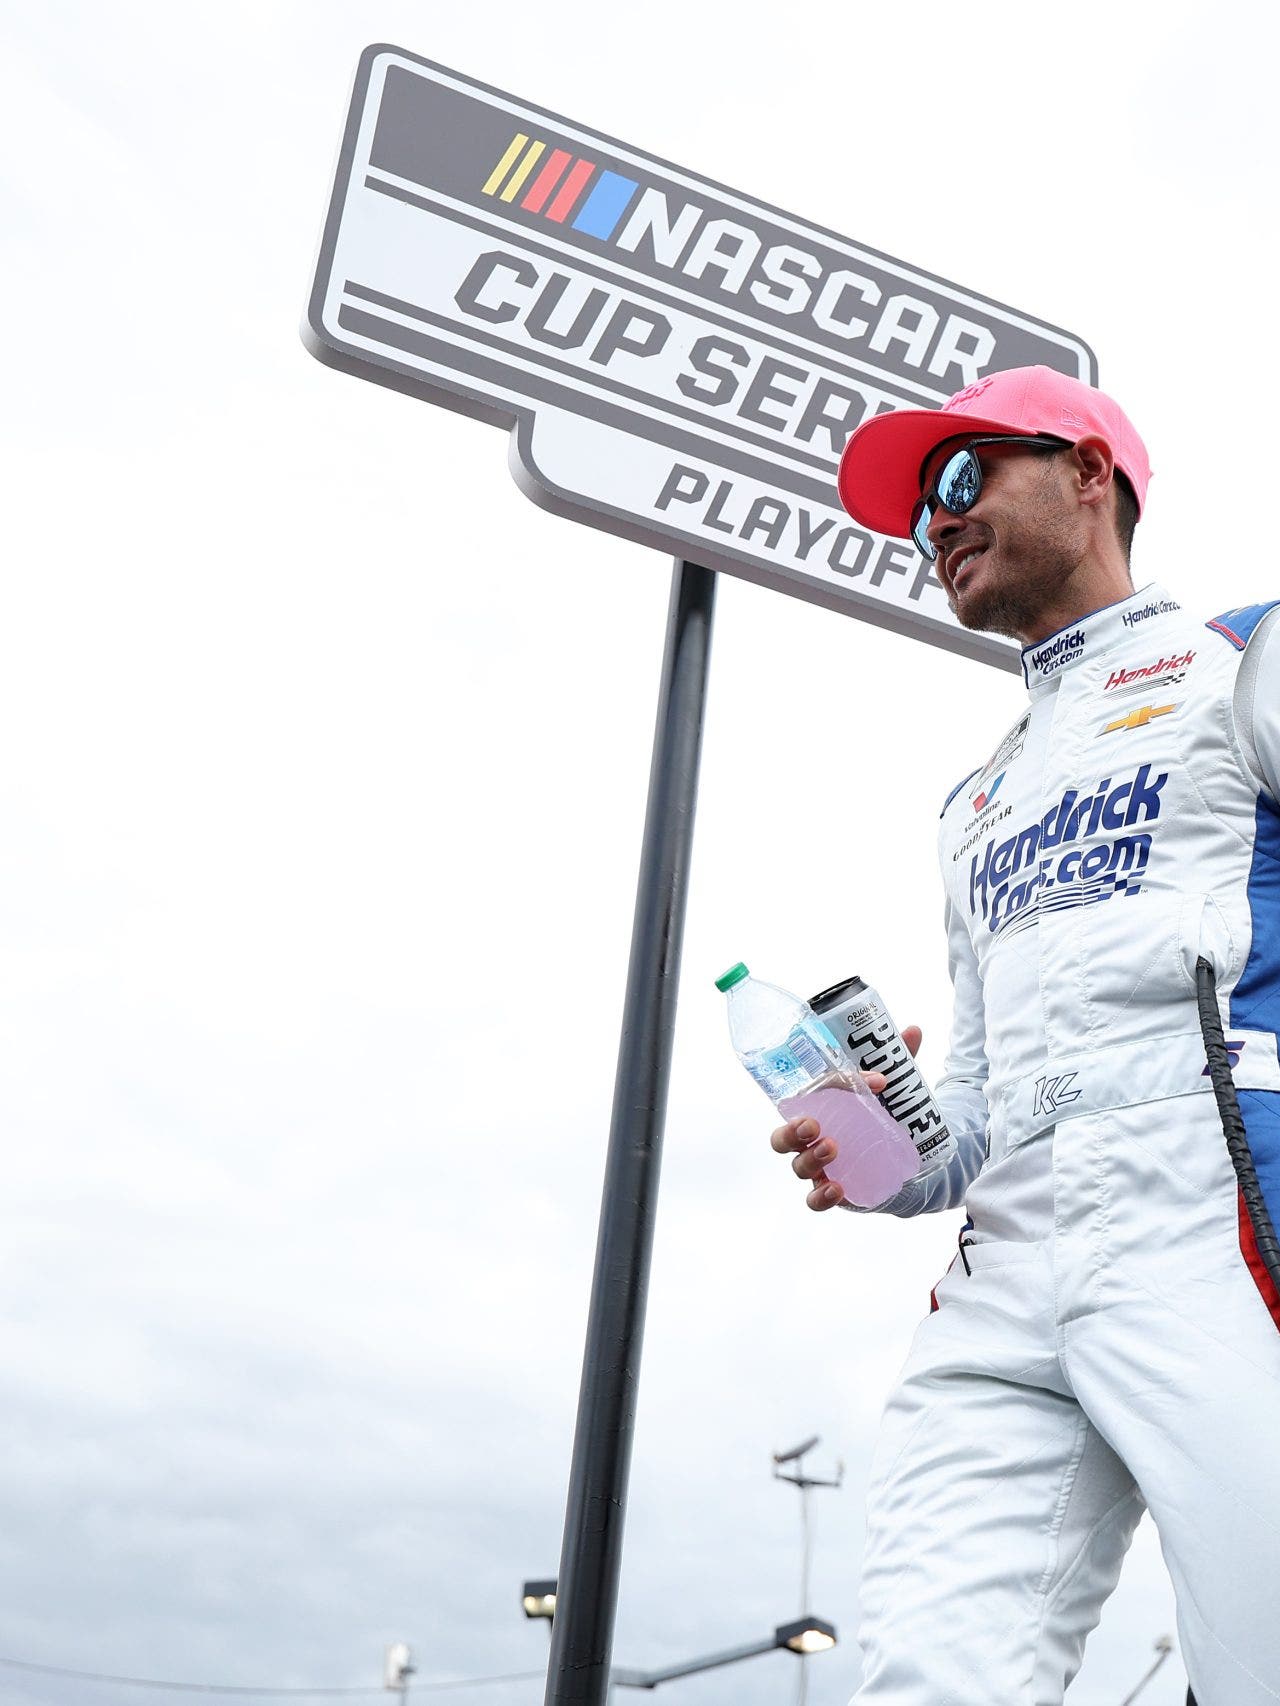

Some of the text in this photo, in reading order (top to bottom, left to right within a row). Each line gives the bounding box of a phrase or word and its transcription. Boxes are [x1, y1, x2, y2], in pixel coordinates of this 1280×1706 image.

[454, 250, 897, 454] CUP SER
[617, 187, 996, 384] NASCAR
[1032, 629, 1086, 671] Hendrick
[1104, 650, 1197, 690] Hendrick
[970, 763, 1169, 921] Hendrick
[847, 1013, 942, 1142] PRIME
